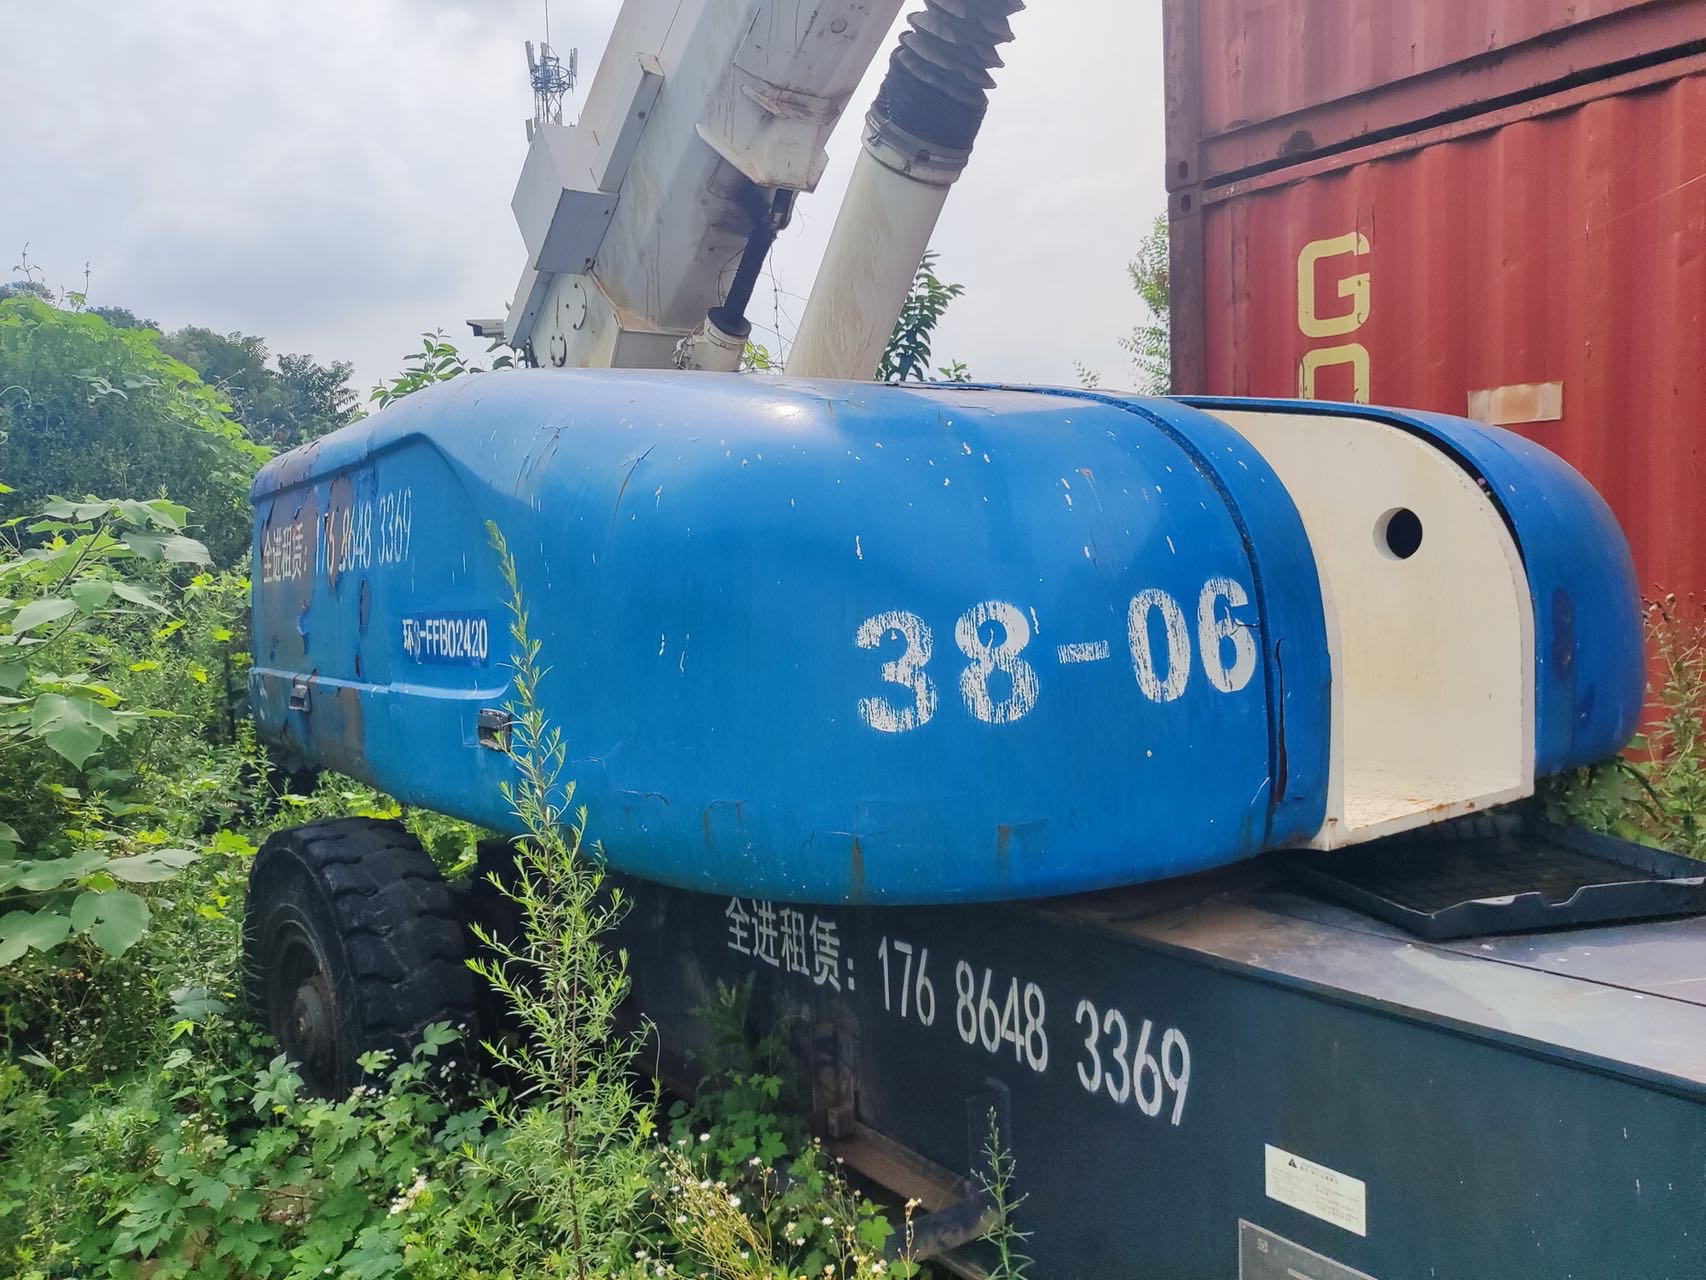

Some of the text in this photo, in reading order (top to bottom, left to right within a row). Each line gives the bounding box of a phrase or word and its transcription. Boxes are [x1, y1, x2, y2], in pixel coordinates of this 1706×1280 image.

[377, 486, 412, 566] 3369
[855, 576, 1257, 732] 38-06
[877, 936, 936, 1027] 176
[955, 959, 1049, 1072] 8648
[1075, 999, 1191, 1127] 3369
